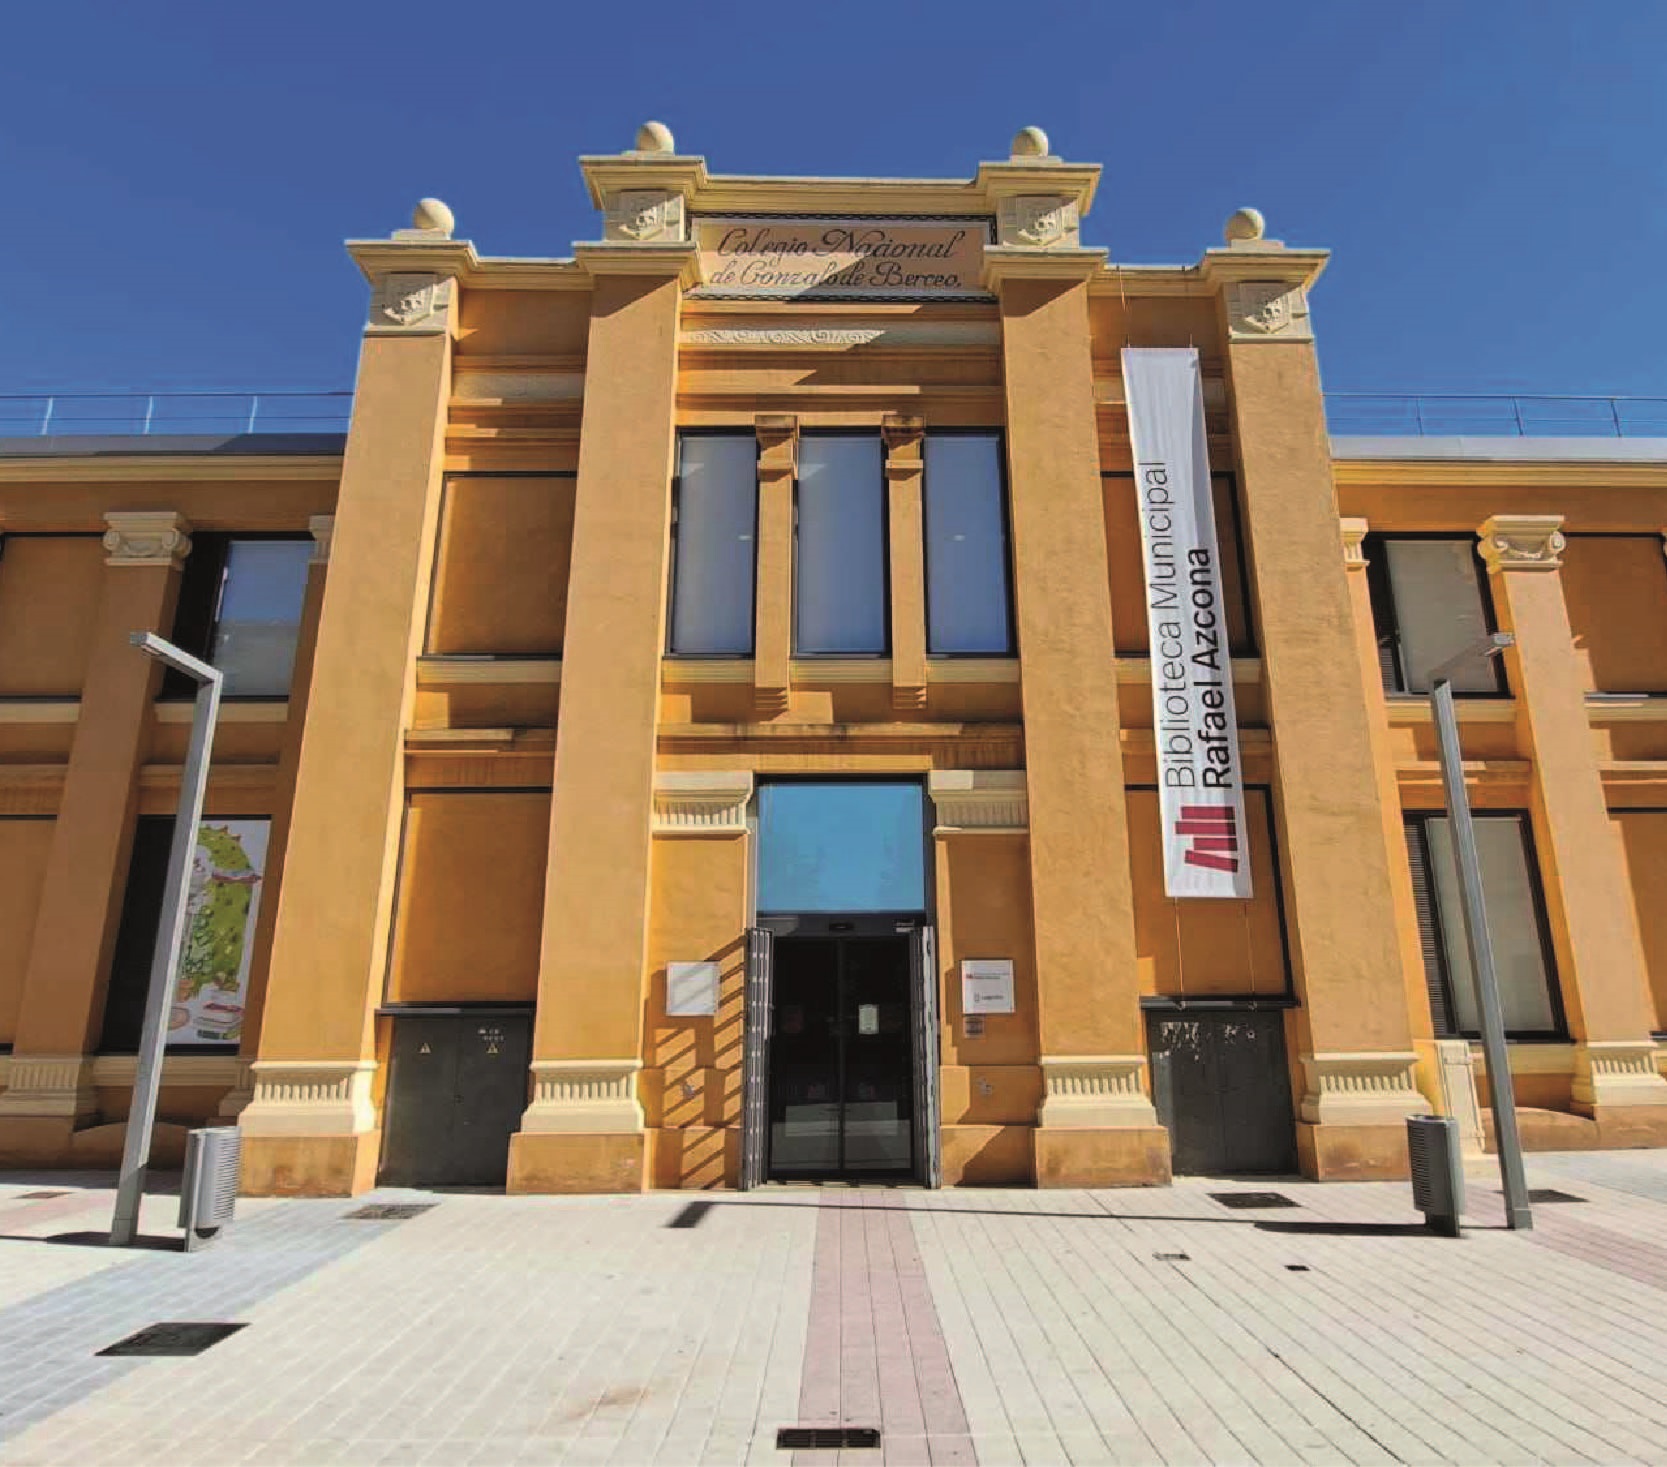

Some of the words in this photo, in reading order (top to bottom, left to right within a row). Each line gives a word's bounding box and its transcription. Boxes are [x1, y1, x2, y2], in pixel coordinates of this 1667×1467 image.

[709, 259, 738, 284] de
[717, 227, 808, 267] Colegio
[814, 228, 966, 258] Nacional
[1138, 462, 1181, 609] Municipal
[1188, 548, 1221, 671] Azcona
[1158, 621, 1196, 788] Biblioteca
[1193, 681, 1233, 789] Rafael
